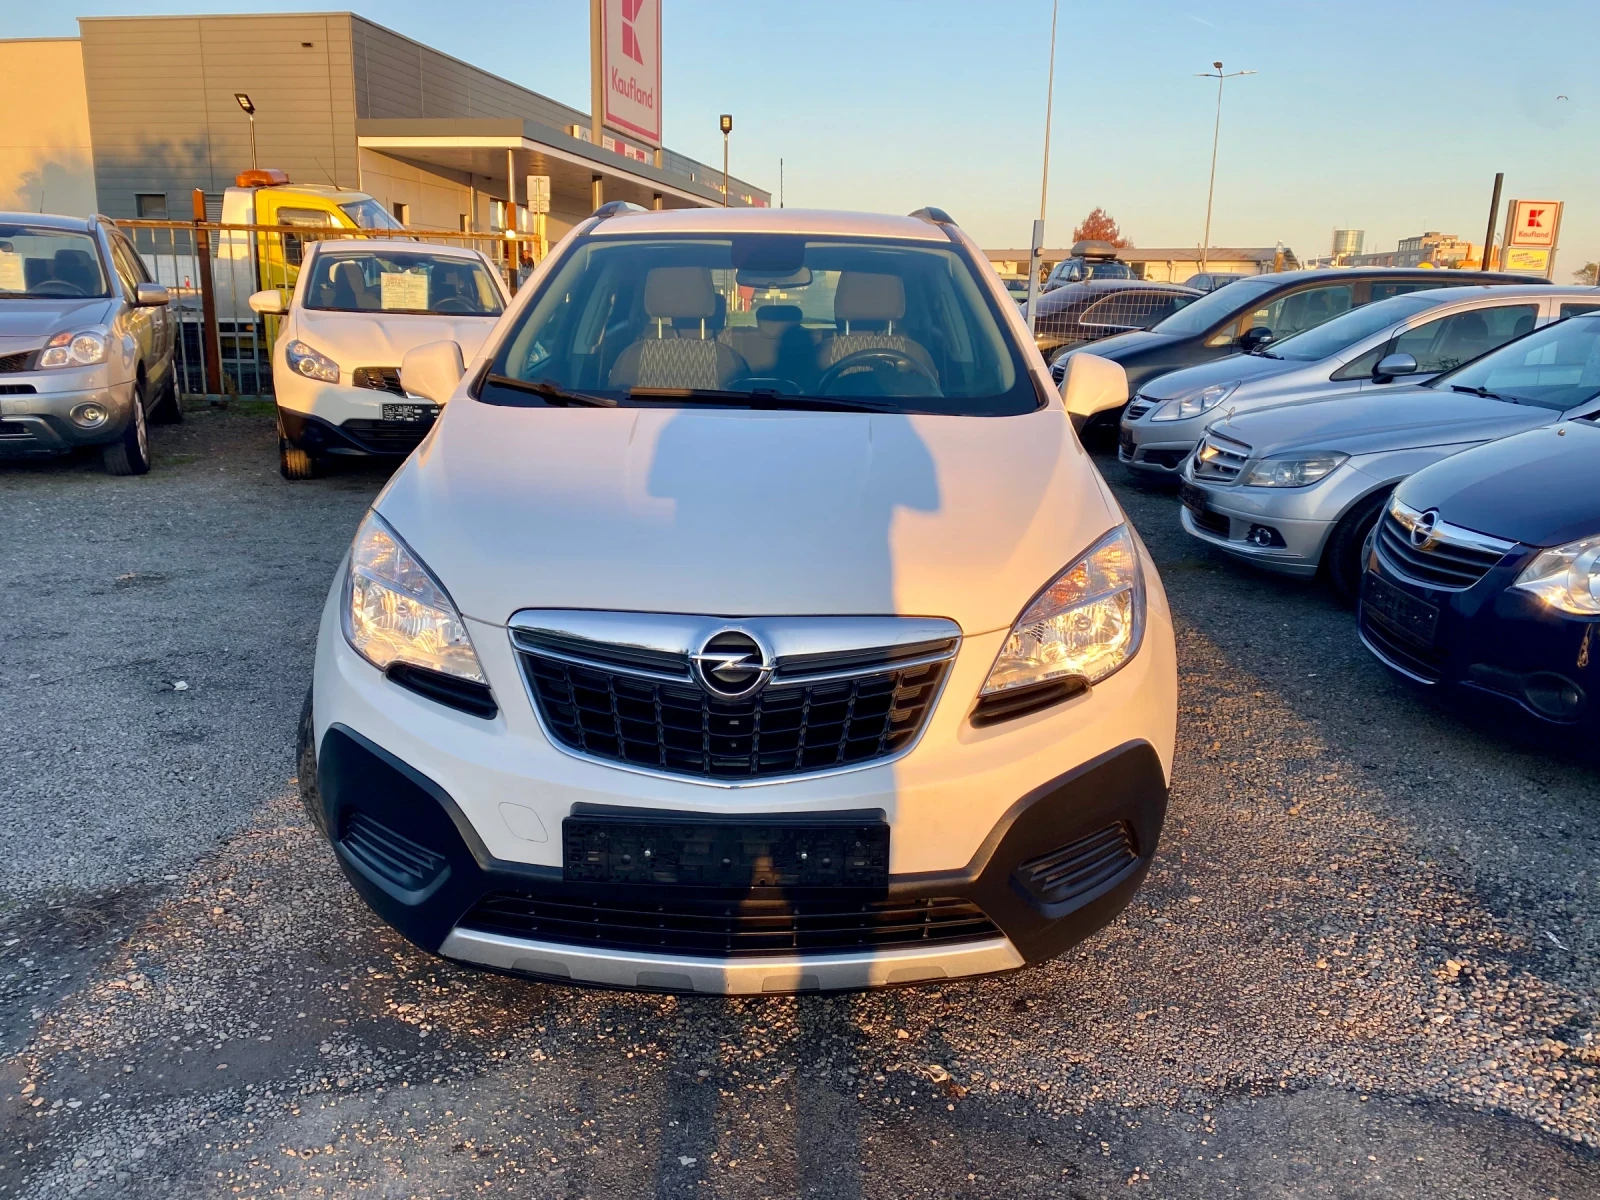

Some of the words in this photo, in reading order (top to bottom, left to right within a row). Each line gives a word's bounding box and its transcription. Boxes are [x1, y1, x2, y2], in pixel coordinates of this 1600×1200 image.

[612, 66, 652, 109] Kaufland
[1528, 210, 1545, 227] K
[1518, 230, 1549, 238] Kaufland
